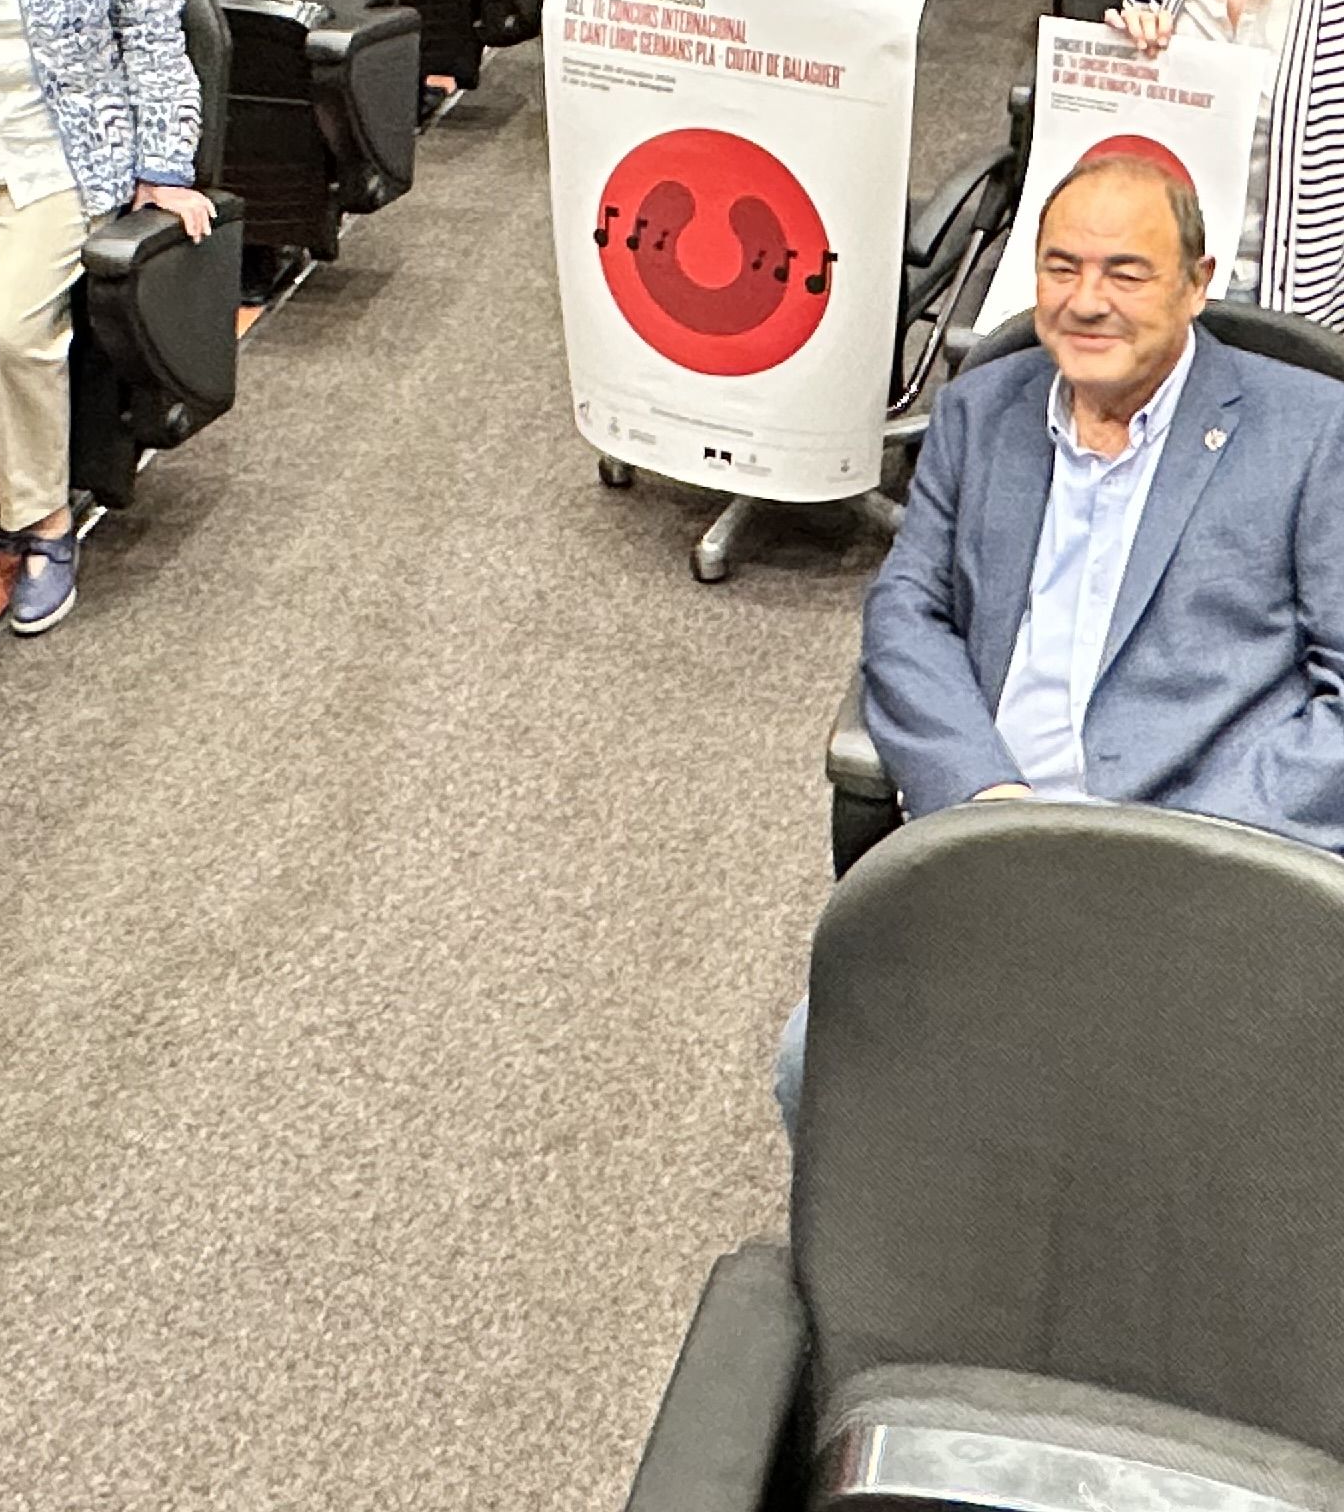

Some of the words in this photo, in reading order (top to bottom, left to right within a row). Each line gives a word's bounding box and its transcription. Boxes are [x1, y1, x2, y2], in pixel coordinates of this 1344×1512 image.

[579, 20, 608, 46] CANT
[640, 31, 693, 62] GERMANS
[696, 41, 715, 67] PLA
[725, 47, 763, 74] CIUTAT
[766, 52, 781, 78] DE
[661, 7, 747, 44] INTERNACIONAL
